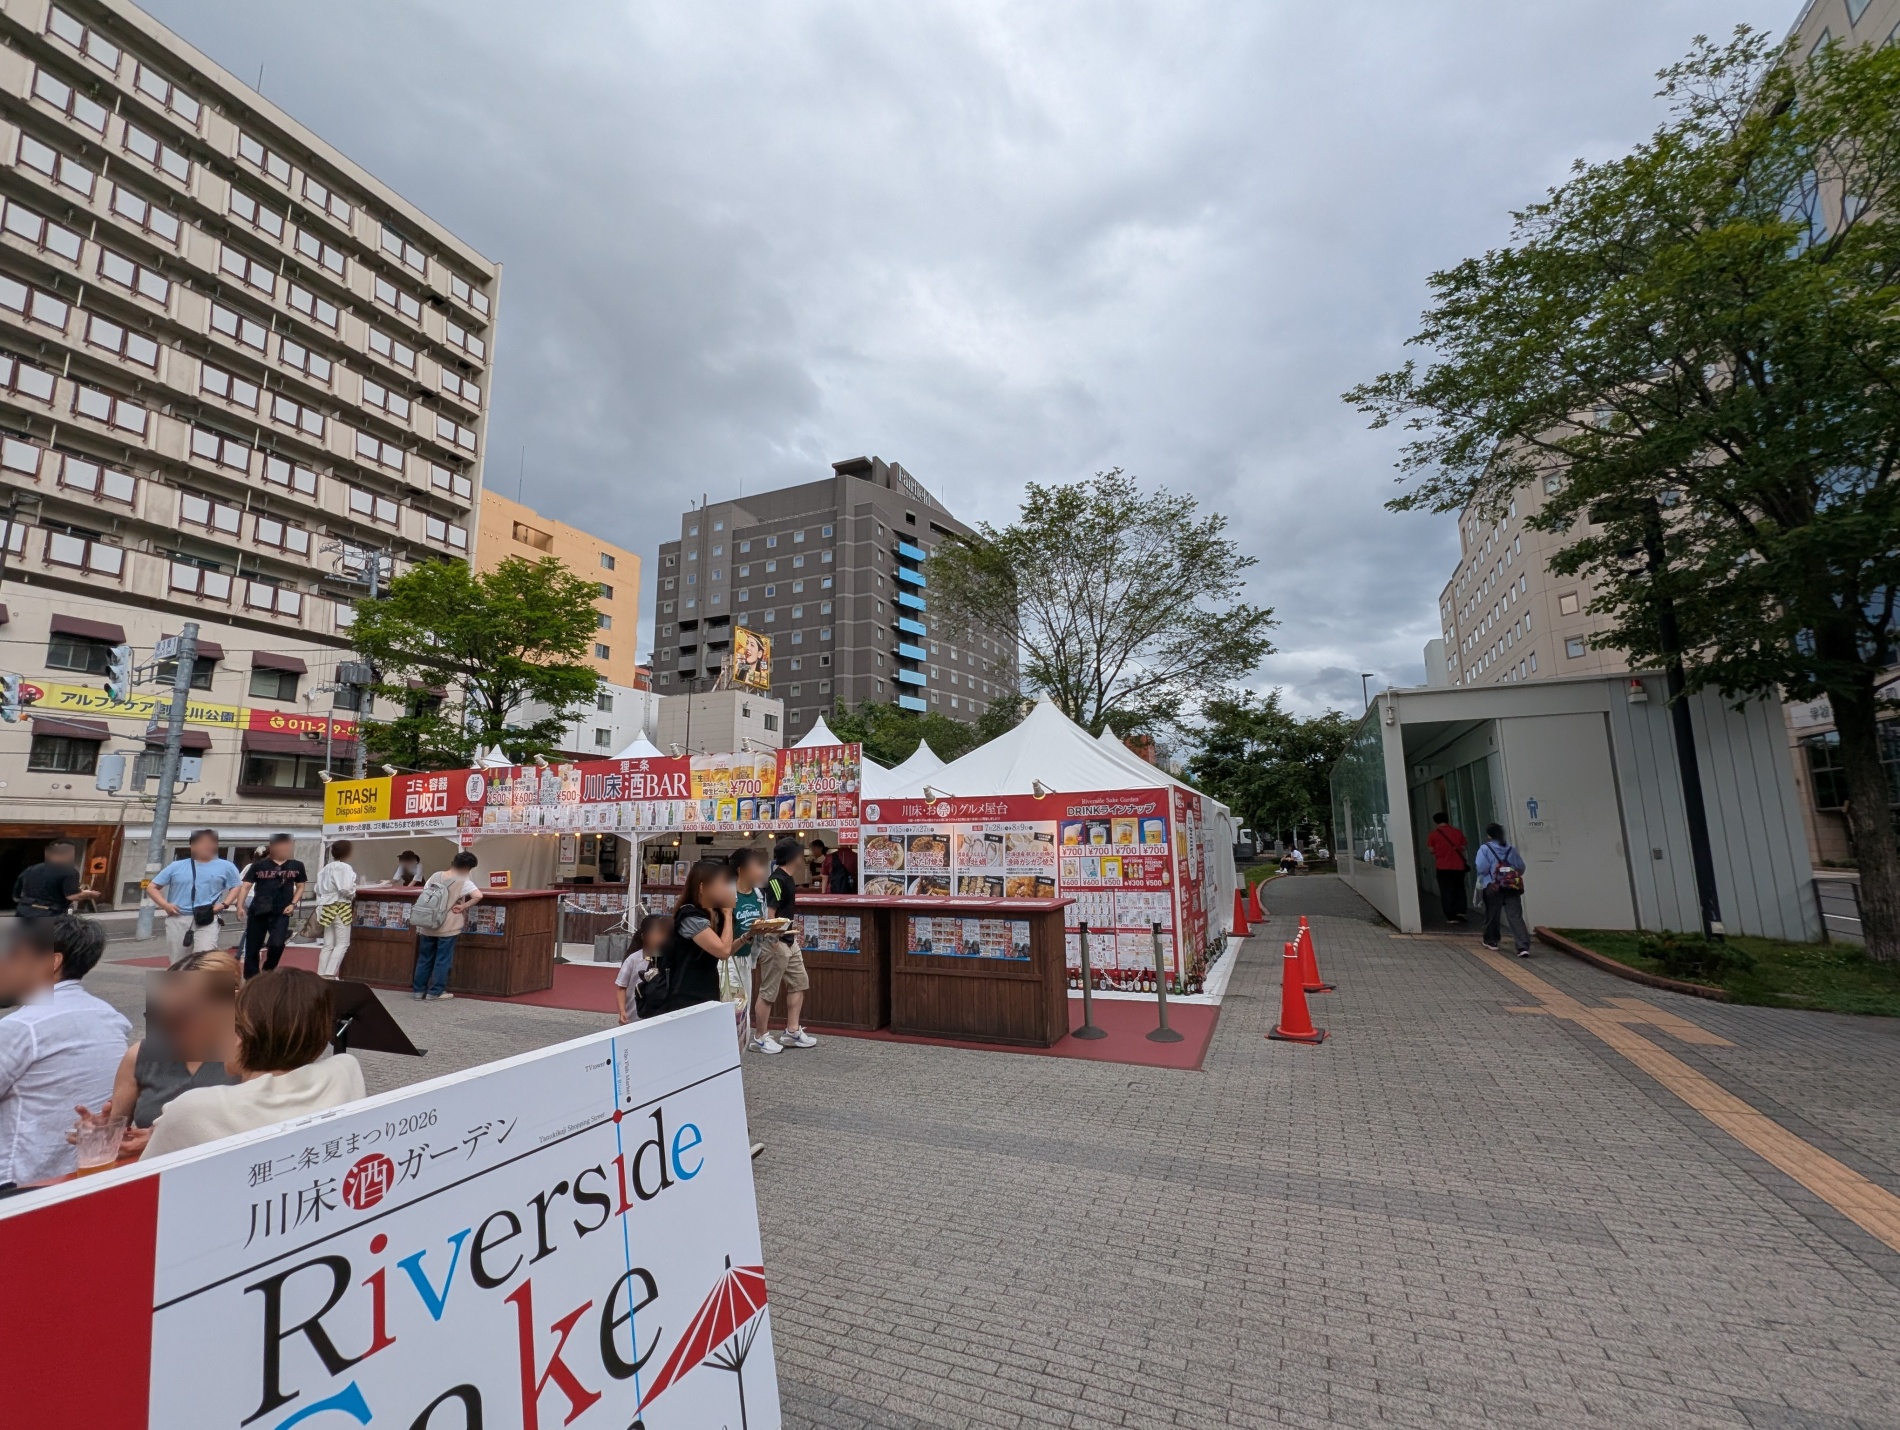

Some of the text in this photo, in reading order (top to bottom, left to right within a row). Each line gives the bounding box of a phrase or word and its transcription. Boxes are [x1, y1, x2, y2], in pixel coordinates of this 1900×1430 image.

[620, 759, 650, 773] 狸二条
[406, 777, 448, 792] ゴミ・容器
[730, 779, 762, 795] ¥700
[337, 787, 378, 805] TRASH
[405, 792, 447, 814] 回収口
[336, 804, 377, 817] Disposal Site
[902, 801, 1009, 818] 川床・お祭りグルメ屋台
[1066, 803, 1156, 816] DRINKラインナップ
[777, 821, 794, 829] ¥700
[1062, 846, 1165, 855] ¥700 ¥700 ¥700 ¥700
[567, 1119, 590, 1132] Shopping
[591, 1112, 606, 1123] Street
[247, 1109, 438, 1187] 狸二条夏まつり2026
[243, 1116, 519, 1250] 川床酒ガーデン
[240, 1107, 705, 1429] Riverside
[272, 1267, 663, 1430] ke
